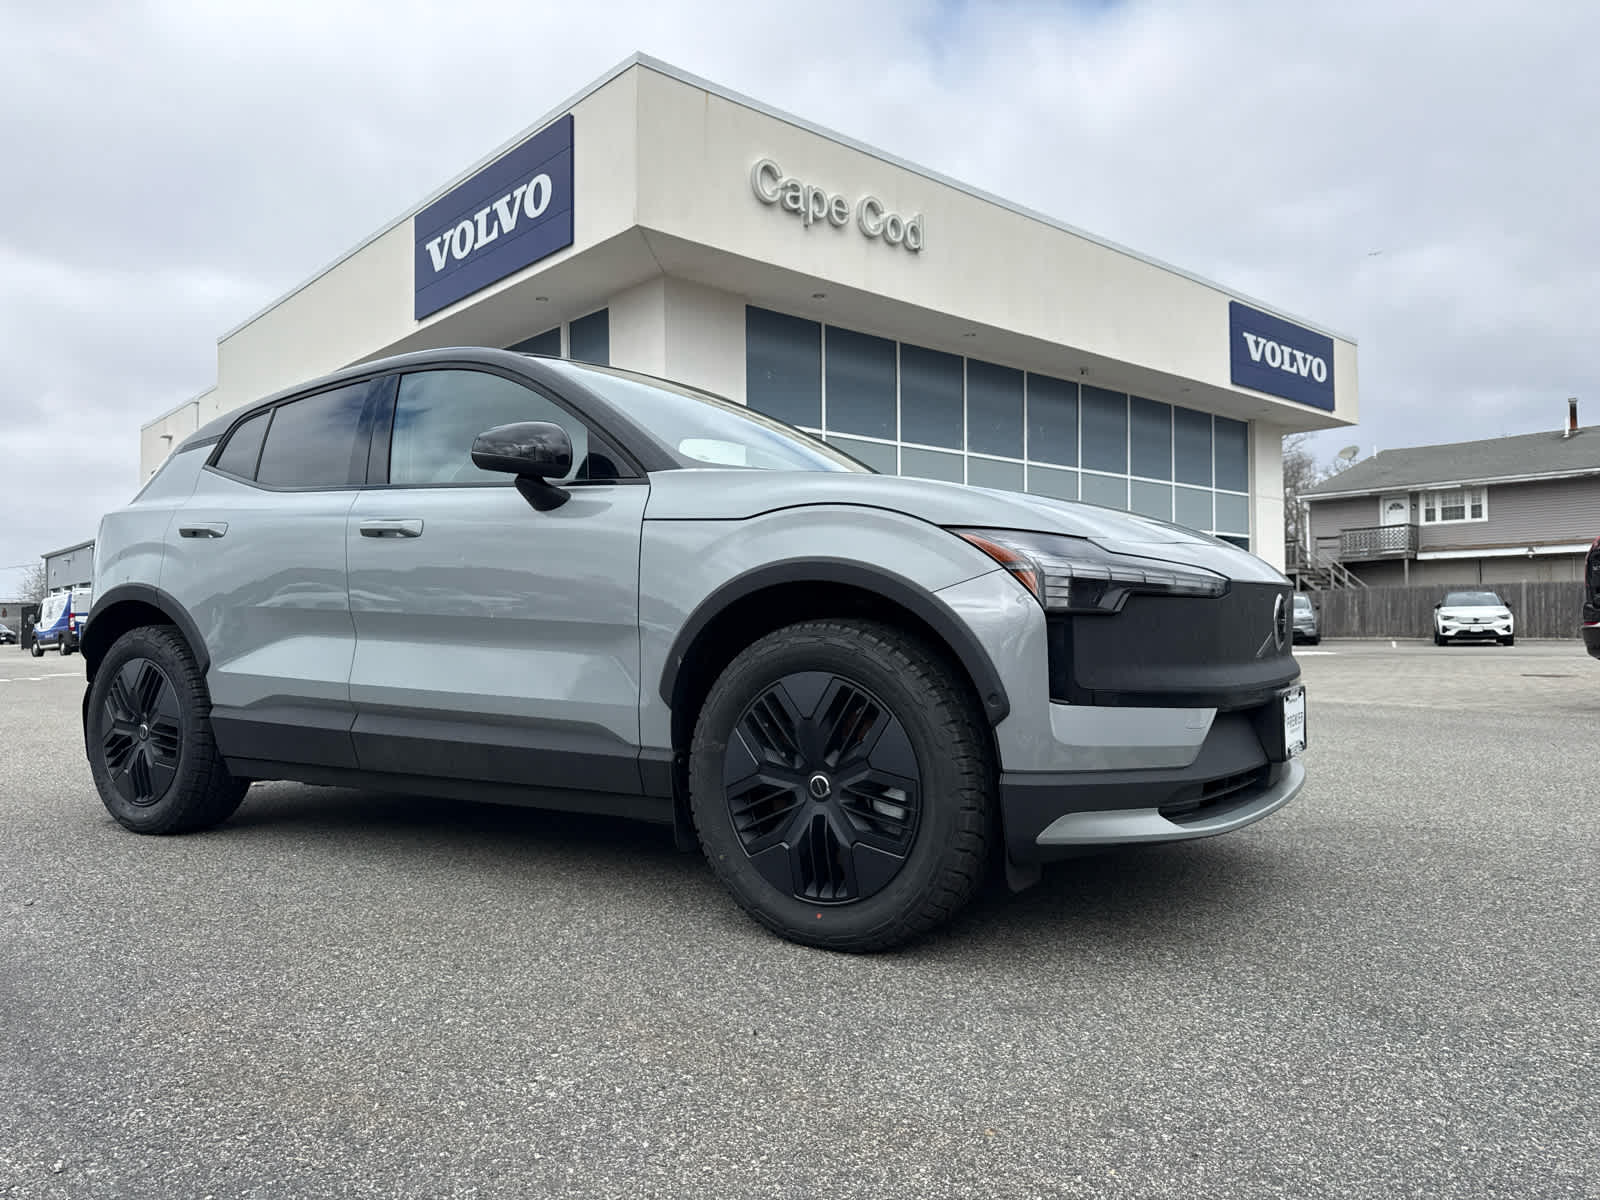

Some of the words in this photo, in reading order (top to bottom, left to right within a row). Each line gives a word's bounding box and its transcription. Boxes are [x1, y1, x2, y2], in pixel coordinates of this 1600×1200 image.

[425, 173, 552, 273] VOLVO
[751, 158, 849, 230] Cape
[856, 195, 924, 251] Cod
[1242, 331, 1327, 383] VOLVO
